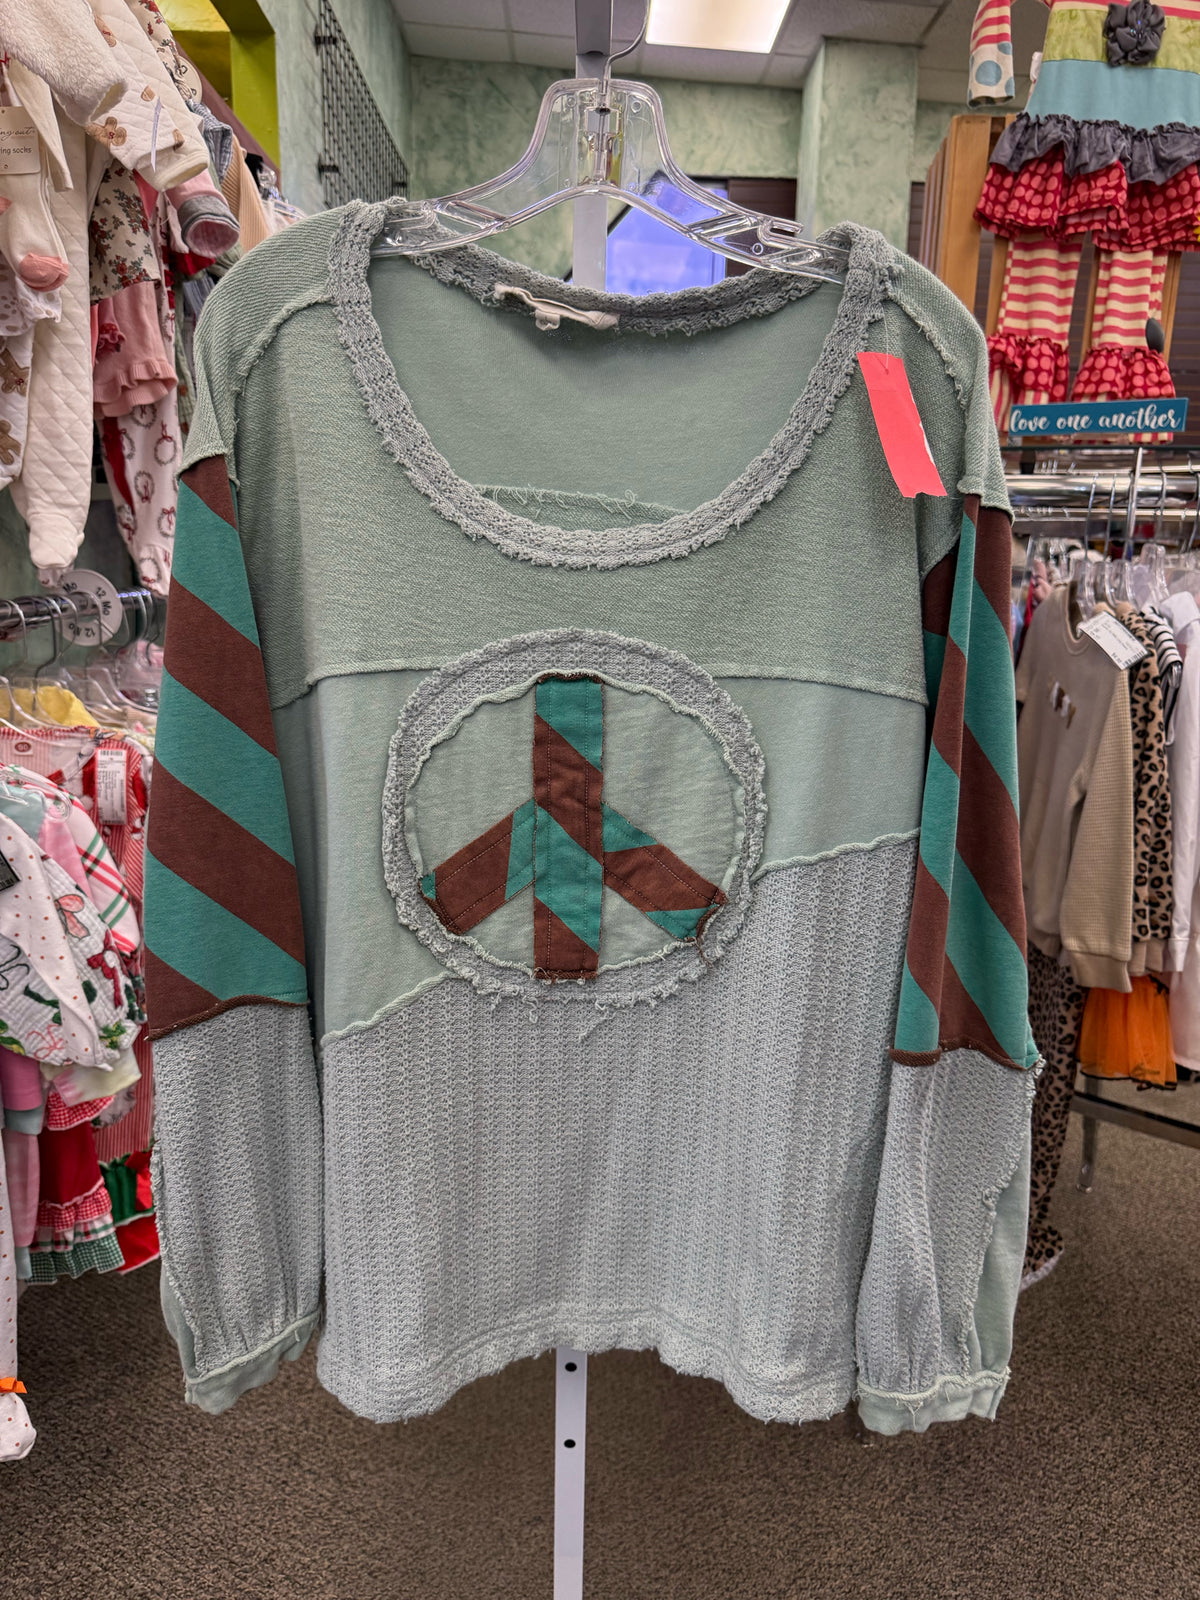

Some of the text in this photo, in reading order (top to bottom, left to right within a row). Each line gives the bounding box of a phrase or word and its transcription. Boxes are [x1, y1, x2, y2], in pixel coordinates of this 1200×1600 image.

[0, 146, 32, 155] ing socks
[1010, 404, 1181, 432] love one another
[62, 582, 78, 593] Mo
[96, 587, 112, 616] 12 Mo
[84, 628, 96, 637] 12
